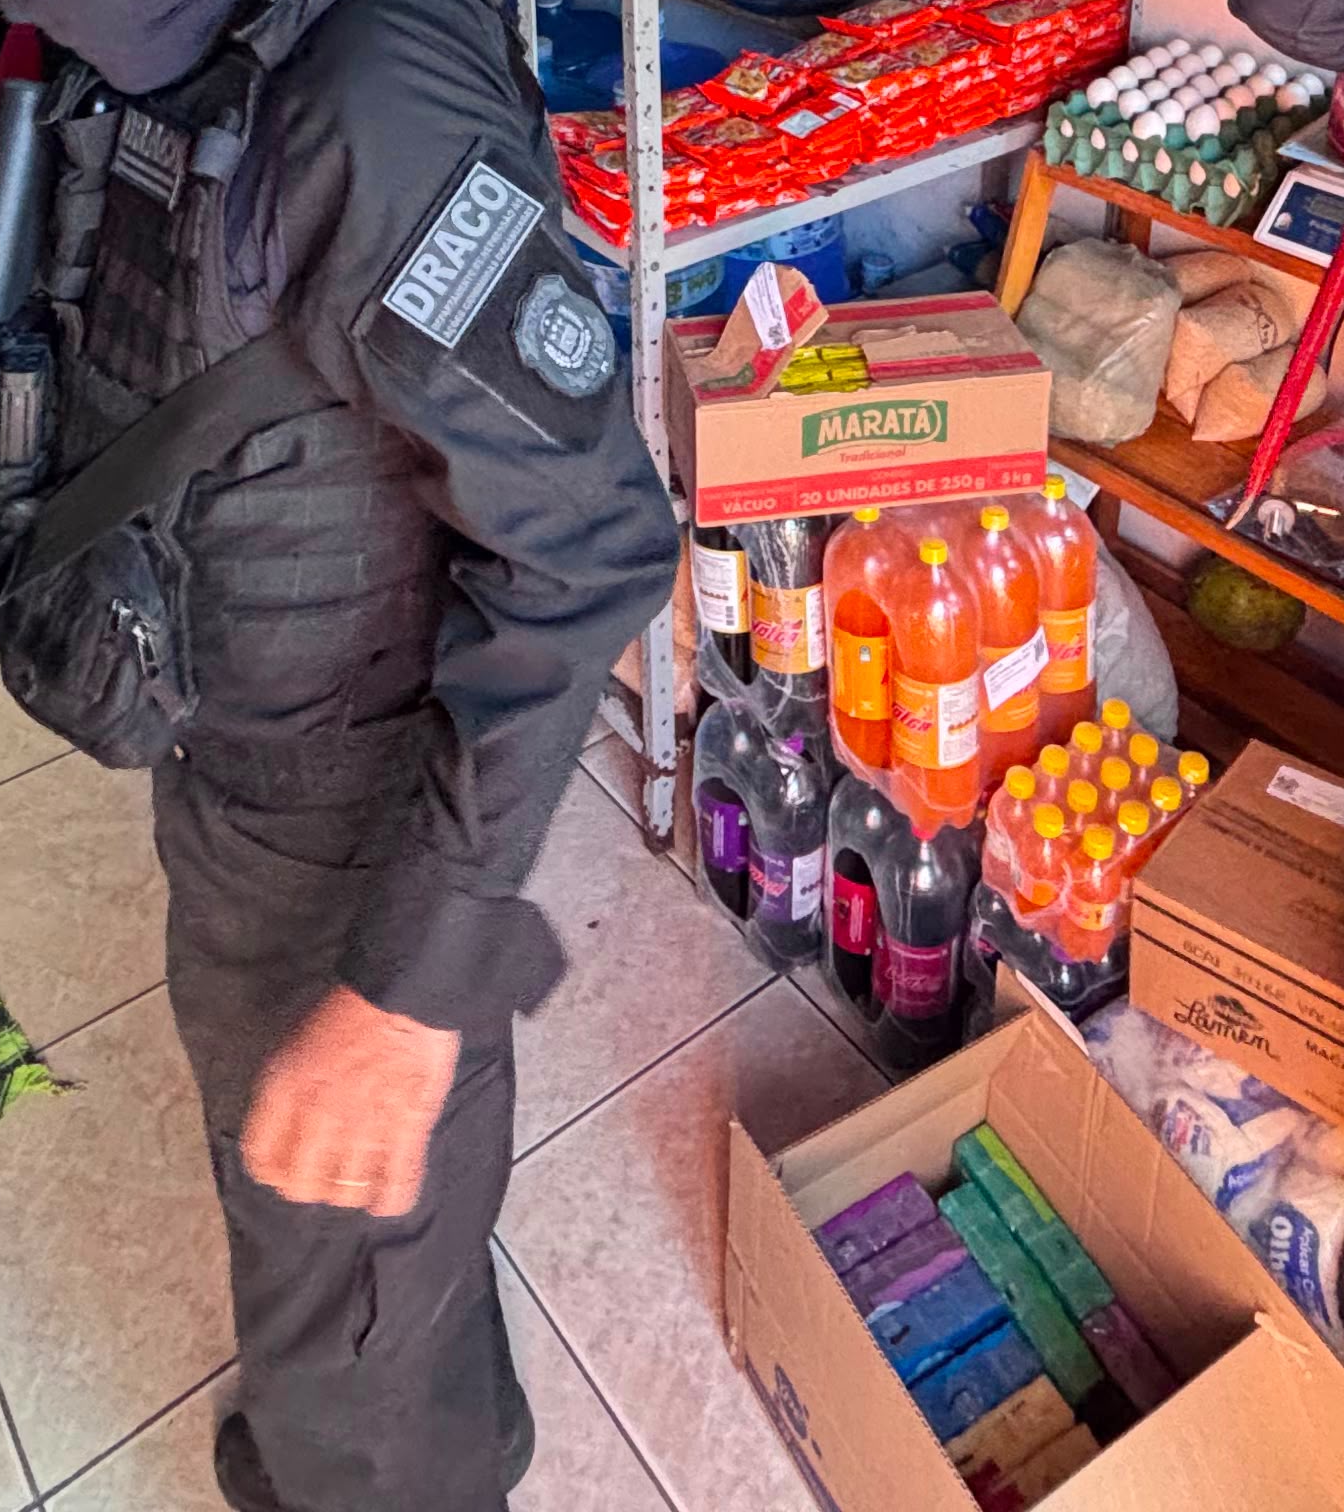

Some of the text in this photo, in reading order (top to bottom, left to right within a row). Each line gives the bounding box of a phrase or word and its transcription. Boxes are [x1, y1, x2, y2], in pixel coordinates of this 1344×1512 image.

[391, 174, 509, 323] DRACO
[840, 445, 906, 464] Tradicional
[722, 494, 777, 514] VÁCUO
[800, 490, 822, 506] 20
[826, 480, 912, 502] UNIDADES
[915, 478, 937, 493] DE
